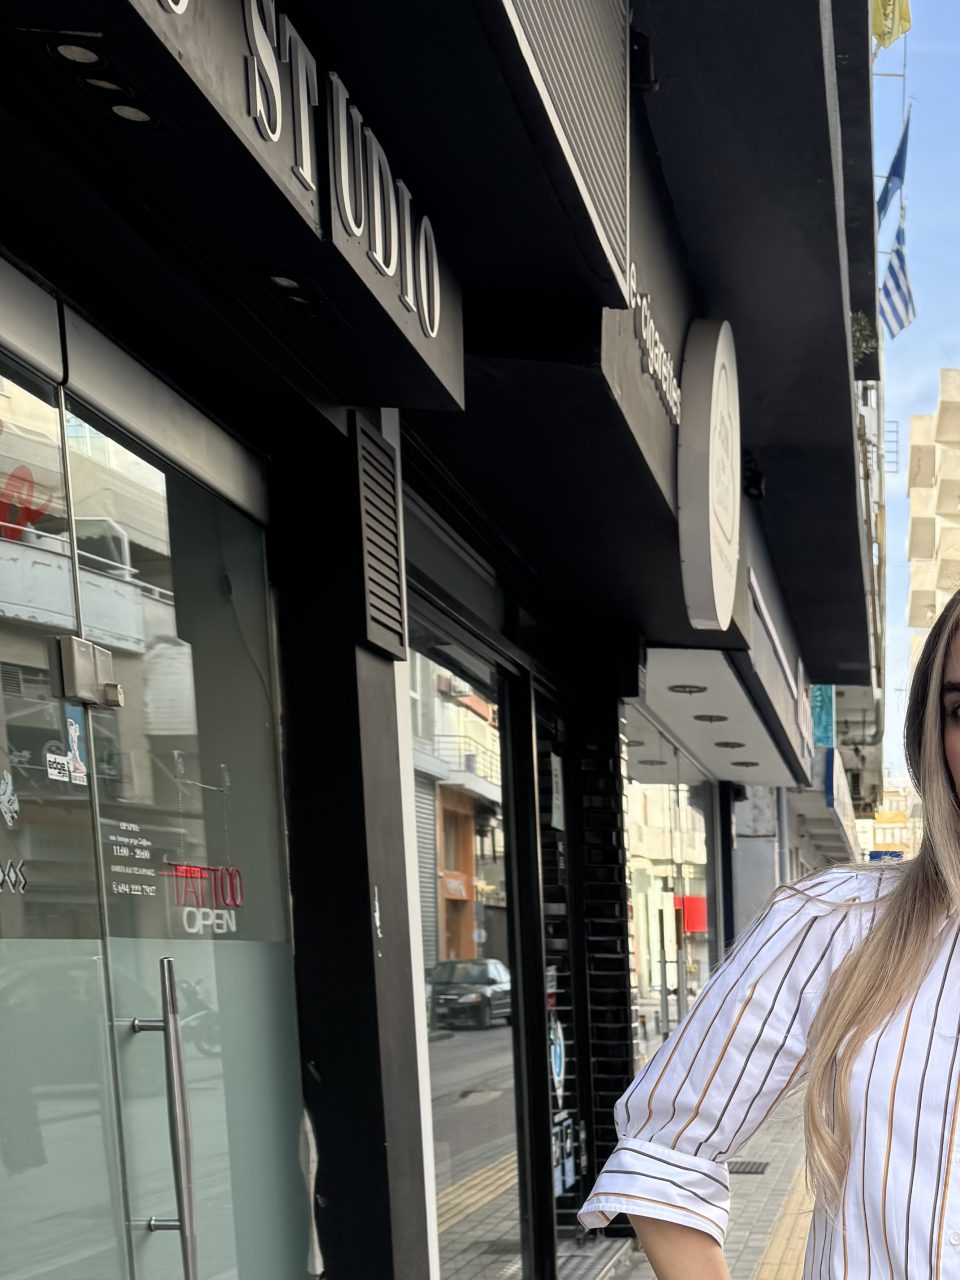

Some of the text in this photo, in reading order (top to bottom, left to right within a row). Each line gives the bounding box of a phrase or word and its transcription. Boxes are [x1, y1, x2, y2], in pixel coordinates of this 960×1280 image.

[243, 0, 441, 338] STUDIO
[171, 862, 243, 909] TATTOO
[183, 906, 237, 934] OPEN
